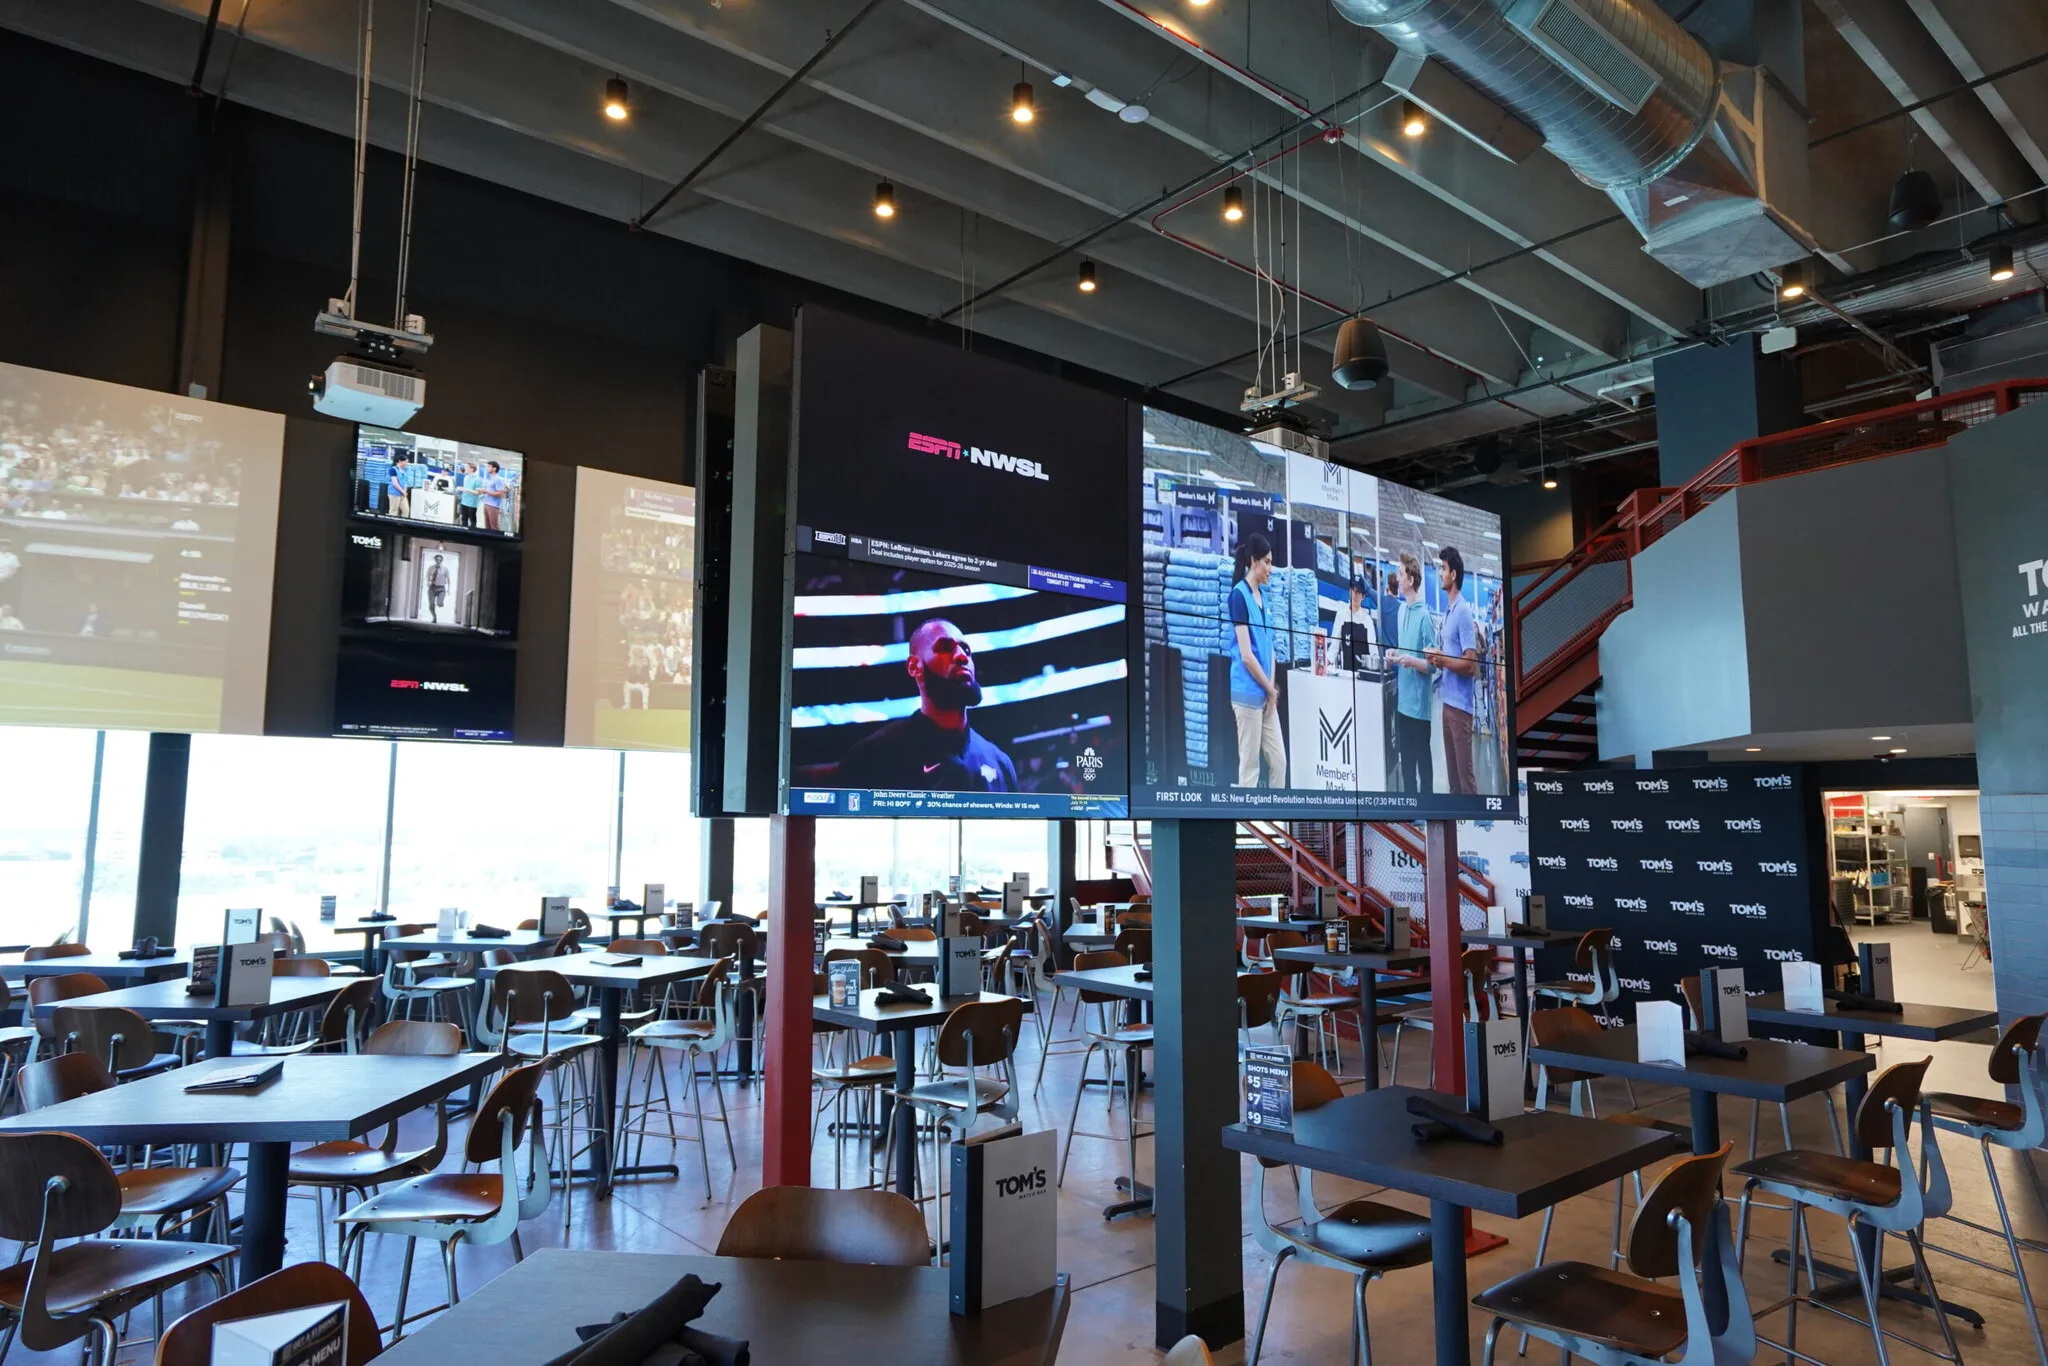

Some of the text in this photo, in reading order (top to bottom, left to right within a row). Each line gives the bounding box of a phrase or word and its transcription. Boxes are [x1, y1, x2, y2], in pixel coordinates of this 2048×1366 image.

[908, 431, 1050, 481] ESPN NWSL
[352, 535, 382, 546] TOM'S
[871, 539, 890, 549] ESPN:
[890, 543, 911, 553] LeBron
[912, 547, 932, 557] James,
[932, 551, 951, 560] Lakers
[952, 554, 967, 562] agree
[883, 550, 904, 560] includes
[905, 554, 920, 562] player
[920, 557, 936, 565] option
[2012, 620, 2048, 638] ALL THE
[390, 680, 469, 692] ESPN NWSL
[1076, 755, 1103, 768] PARIS
[1316, 764, 1356, 782] Member's
[1534, 781, 1563, 791] TOM'S
[1583, 780, 1614, 791] TOM'S
[1636, 779, 1669, 790] TOM'S
[1693, 777, 1728, 789] TOM'S
[1754, 774, 1792, 787] TOM'S
[931, 792, 955, 800] Weather
[1156, 791, 1180, 802] FIRST
[1180, 792, 1202, 802] LOOK
[1211, 793, 1228, 802] MLS:
[1230, 794, 1244, 803] New
[1246, 794, 1272, 805] England
[1273, 795, 1306, 804] Revolution
[1306, 796, 1322, 805] hosts
[1324, 796, 1344, 805] Atlanta
[1365, 797, 1374, 805] FC
[1388, 797, 1397, 806] PM
[1486, 797, 1502, 810] FS2
[1560, 818, 1590, 829] TOM'S
[1611, 818, 1643, 829] TOM'S
[1666, 818, 1700, 830] TOM'S
[1724, 818, 1761, 830] TOM'S
[1537, 856, 1566, 866] TOM'S
[1587, 857, 1618, 868] TOM'S
[1640, 859, 1673, 870] TOM'S
[1697, 860, 1733, 872] TOM'S
[1759, 861, 1797, 873] TOM'S
[1564, 895, 1594, 906] TOM'S
[1615, 898, 1647, 909] TOM'S
[1670, 900, 1705, 912] TOM'S
[1729, 903, 1767, 916] TOM'S
[1644, 940, 1677, 952] TOM'S
[1702, 944, 1738, 957] TOM'S
[955, 949, 976, 958] TOM'S
[1764, 949, 1803, 961] TOM'S
[240, 957, 267, 966] TOM'S
[1618, 978, 1650, 990] TOM'S
[1722, 984, 1741, 995] TOM'S
[1493, 1039, 1516, 1056] TOM'S
[1248, 1064, 1288, 1076] SHOTS MENU
[1248, 1075, 1260, 1088] $5
[1248, 1092, 1260, 1105] $7
[1248, 1111, 1262, 1124] $9
[996, 1166, 1046, 1198] TOM'S
[312, 1336, 341, 1366] MENU
